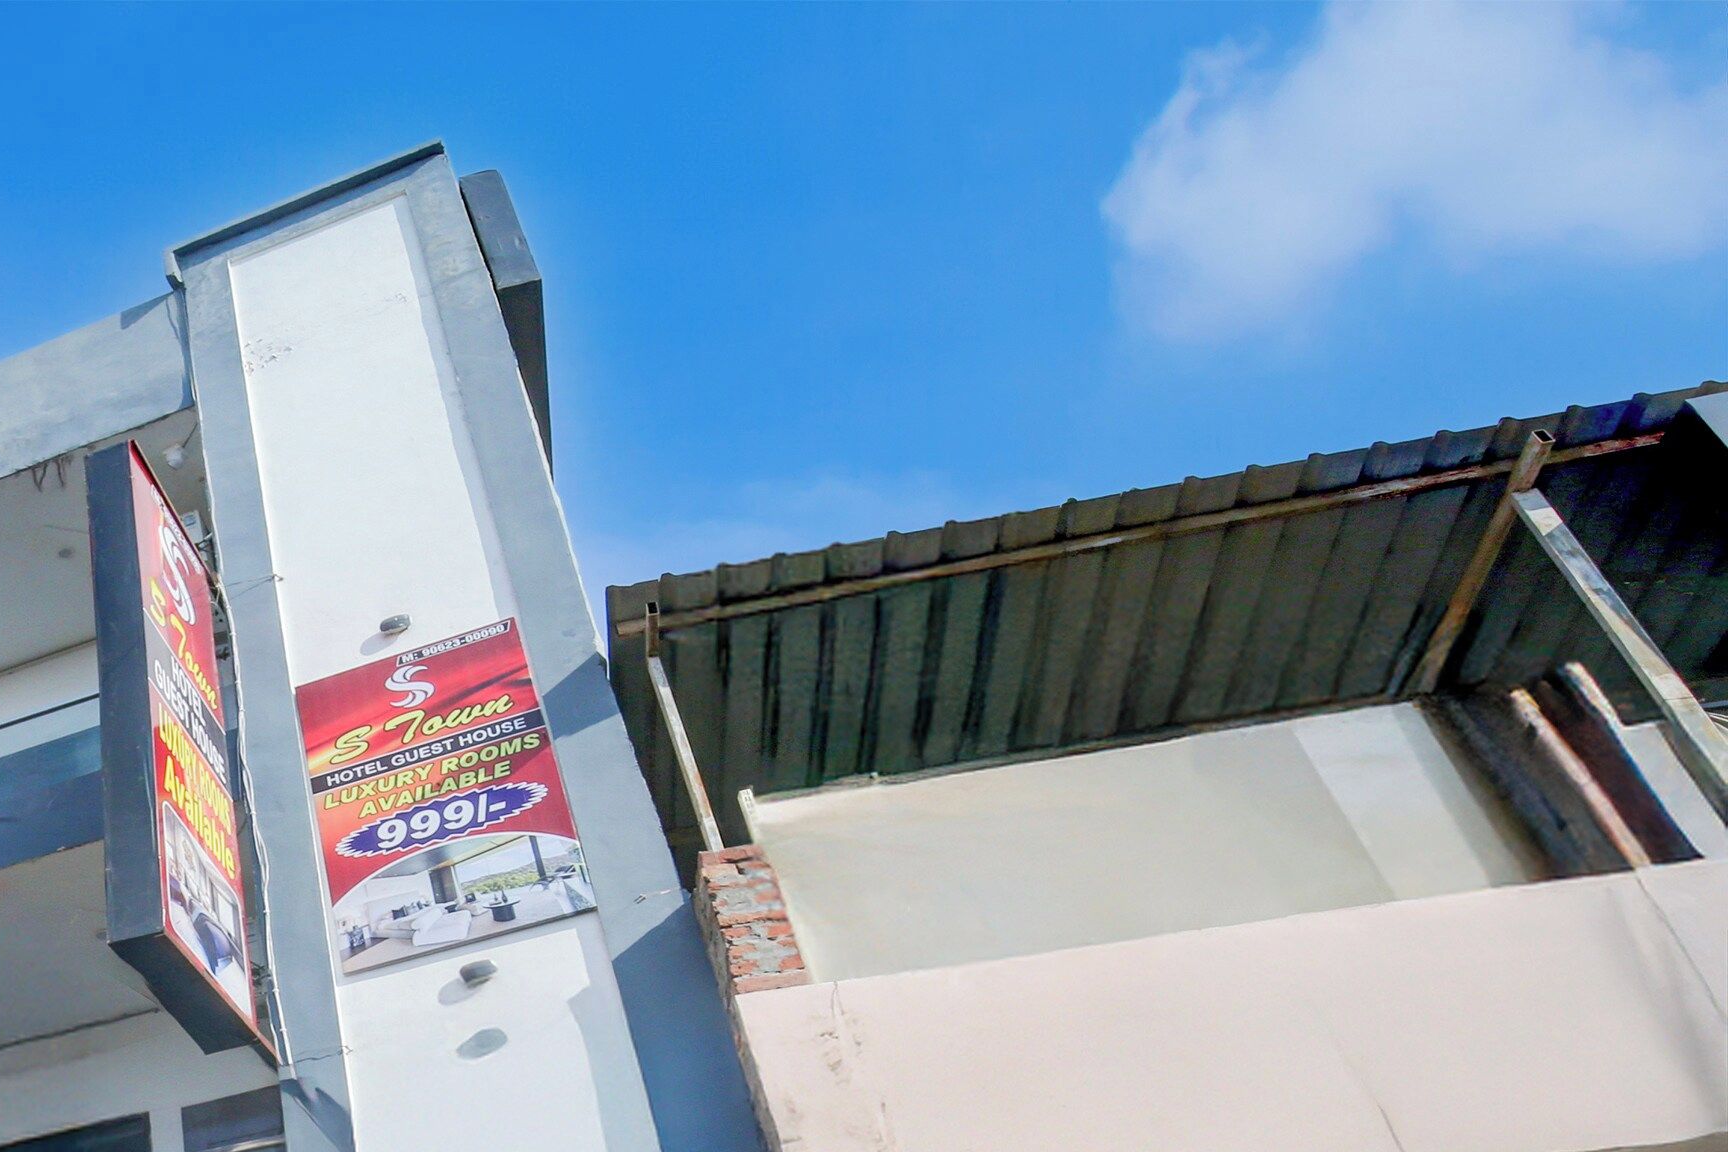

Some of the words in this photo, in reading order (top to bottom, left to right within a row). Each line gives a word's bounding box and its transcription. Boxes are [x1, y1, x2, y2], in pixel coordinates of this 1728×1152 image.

[149, 576, 167, 627] S
[169, 613, 218, 710] Town
[402, 652, 419, 664] M:
[154, 659, 191, 729] GUEST
[190, 712, 227, 785] HOUSE
[171, 655, 207, 727] HOTEL
[326, 760, 388, 788] HOTEL
[391, 738, 455, 767] GUEST
[459, 716, 527, 746] HOUSE
[328, 725, 373, 765] S
[383, 694, 514, 745] Town
[158, 701, 197, 784] LUXURY
[198, 760, 233, 836] ROOMS
[323, 763, 435, 811] LUXURY
[440, 733, 542, 776] ROOMS
[358, 759, 512, 819] AVAILABLE
[163, 755, 237, 880] Available
